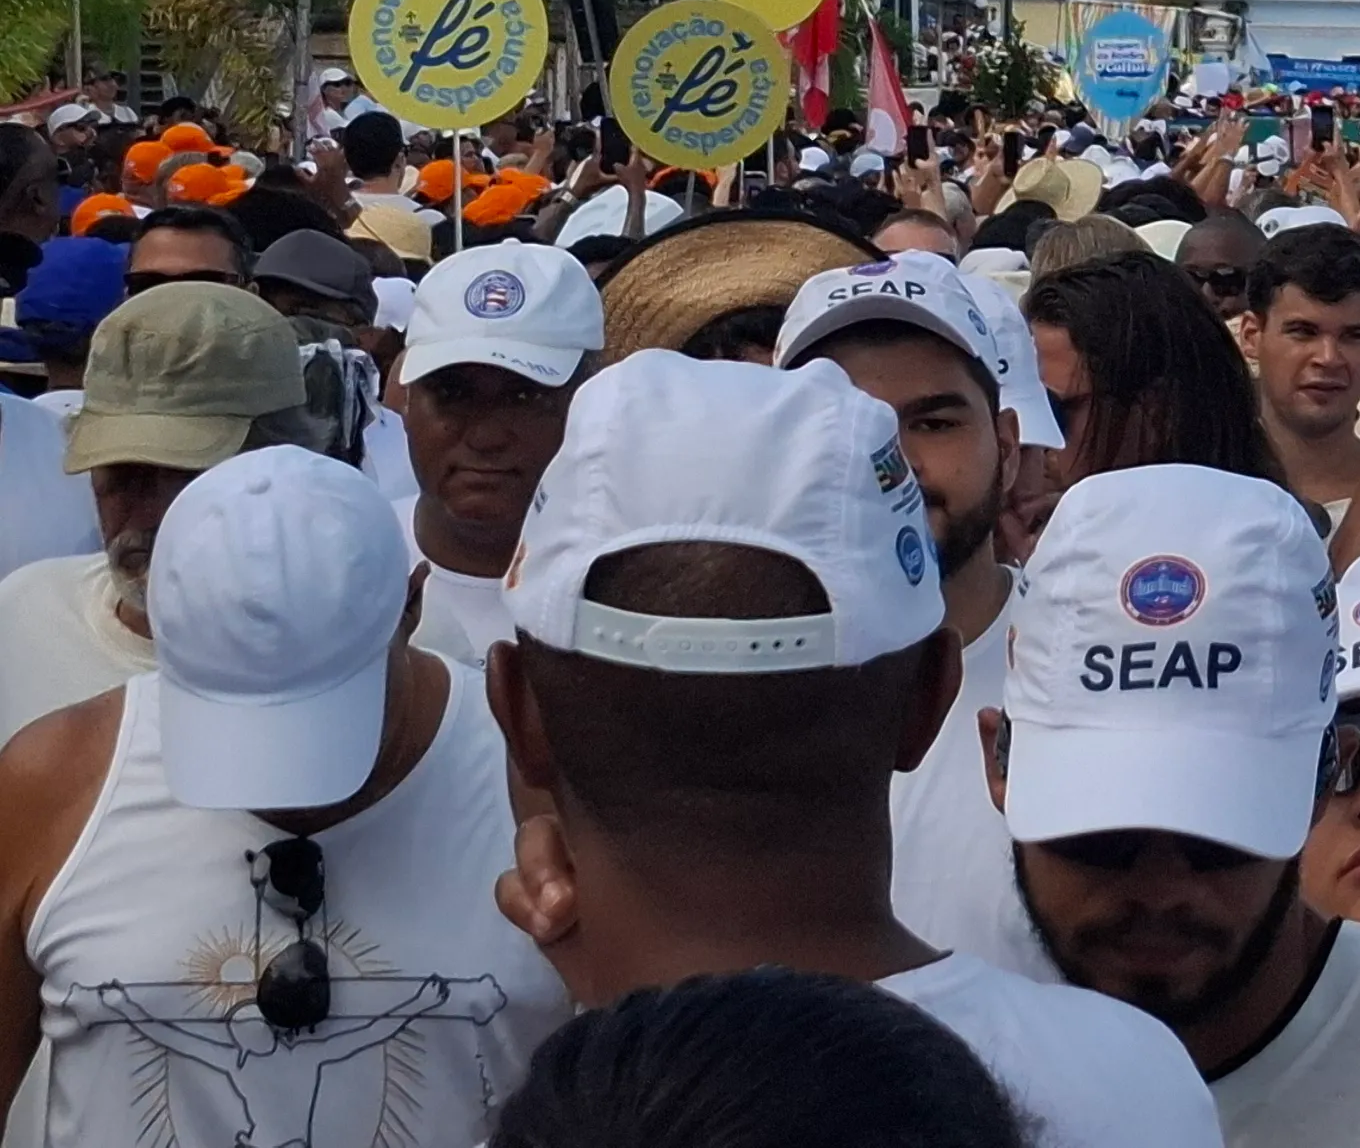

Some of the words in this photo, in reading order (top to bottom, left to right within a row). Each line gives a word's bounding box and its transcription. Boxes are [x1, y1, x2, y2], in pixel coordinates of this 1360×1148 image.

[415, 0, 535, 116] esperança
[631, 12, 726, 119] renovação
[651, 45, 746, 133] fé
[664, 58, 776, 156] esperança
[1080, 640, 1243, 692] SEAP
